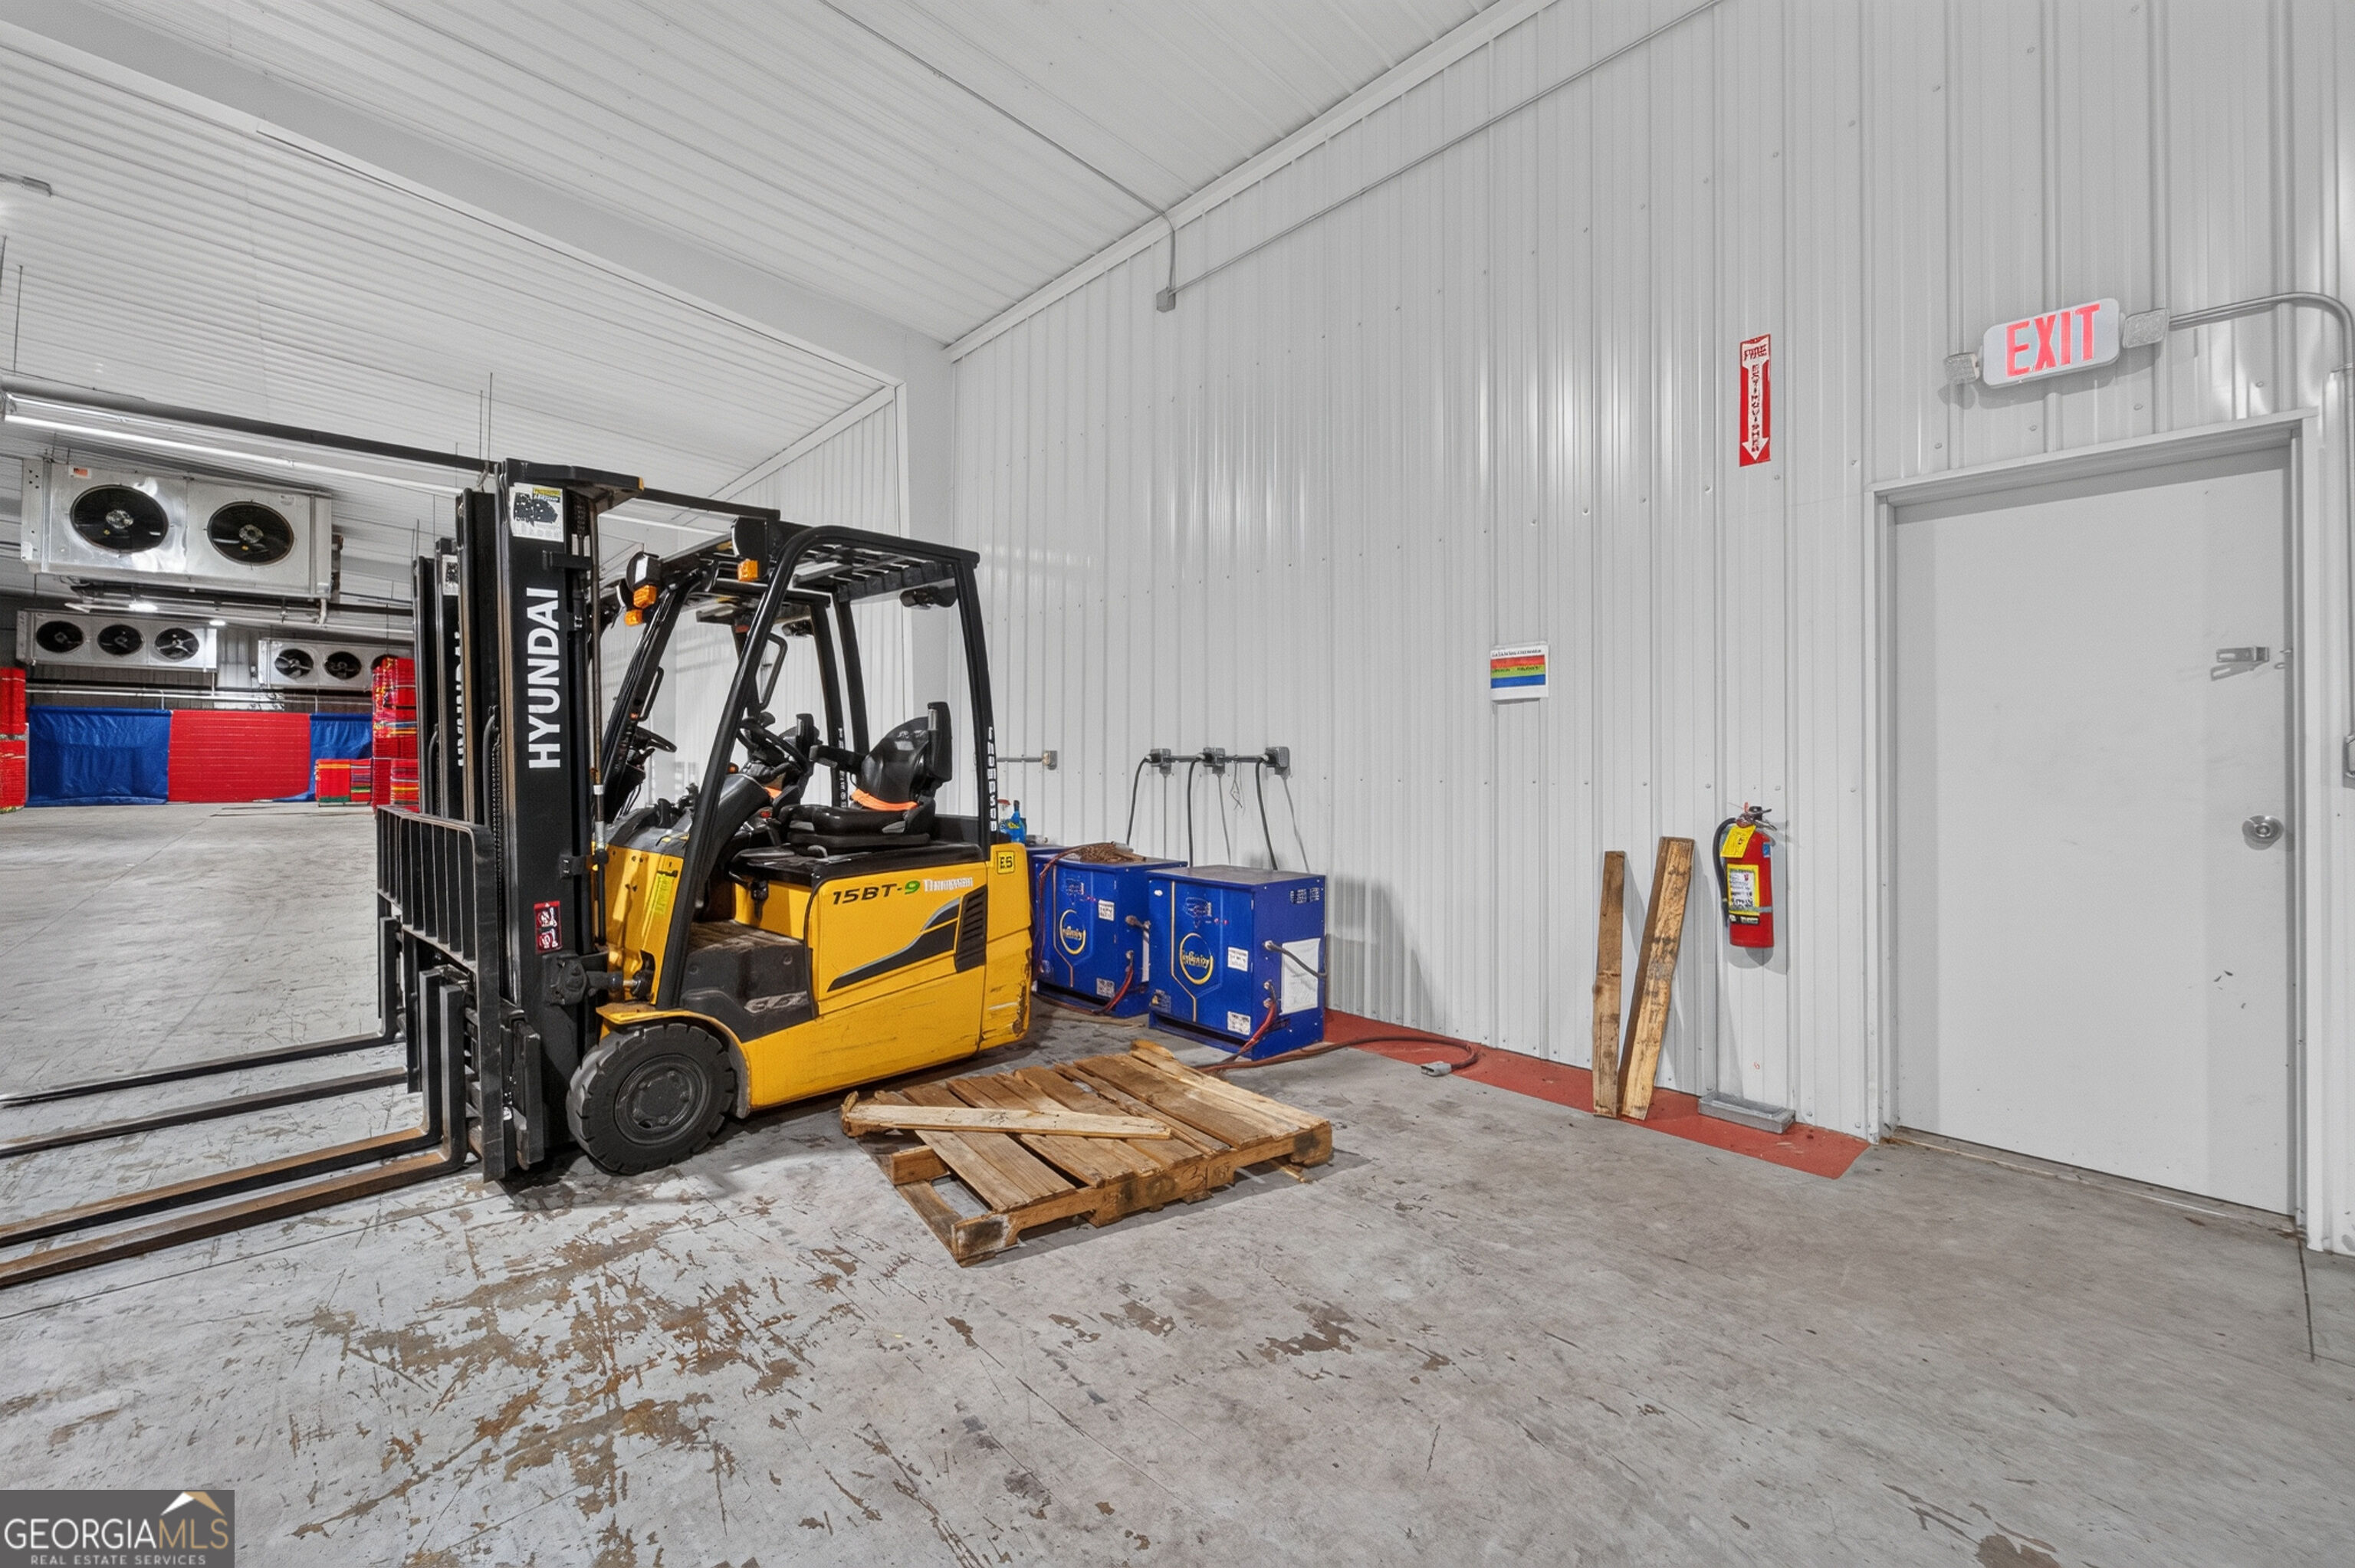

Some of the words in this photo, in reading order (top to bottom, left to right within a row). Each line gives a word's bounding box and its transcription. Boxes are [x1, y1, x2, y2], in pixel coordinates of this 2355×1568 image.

[1744, 344, 1767, 361] FIRE
[2005, 303, 2100, 377] EXIT
[527, 587, 561, 769] HYUNDAI
[833, 880, 921, 905] 15BT-9
